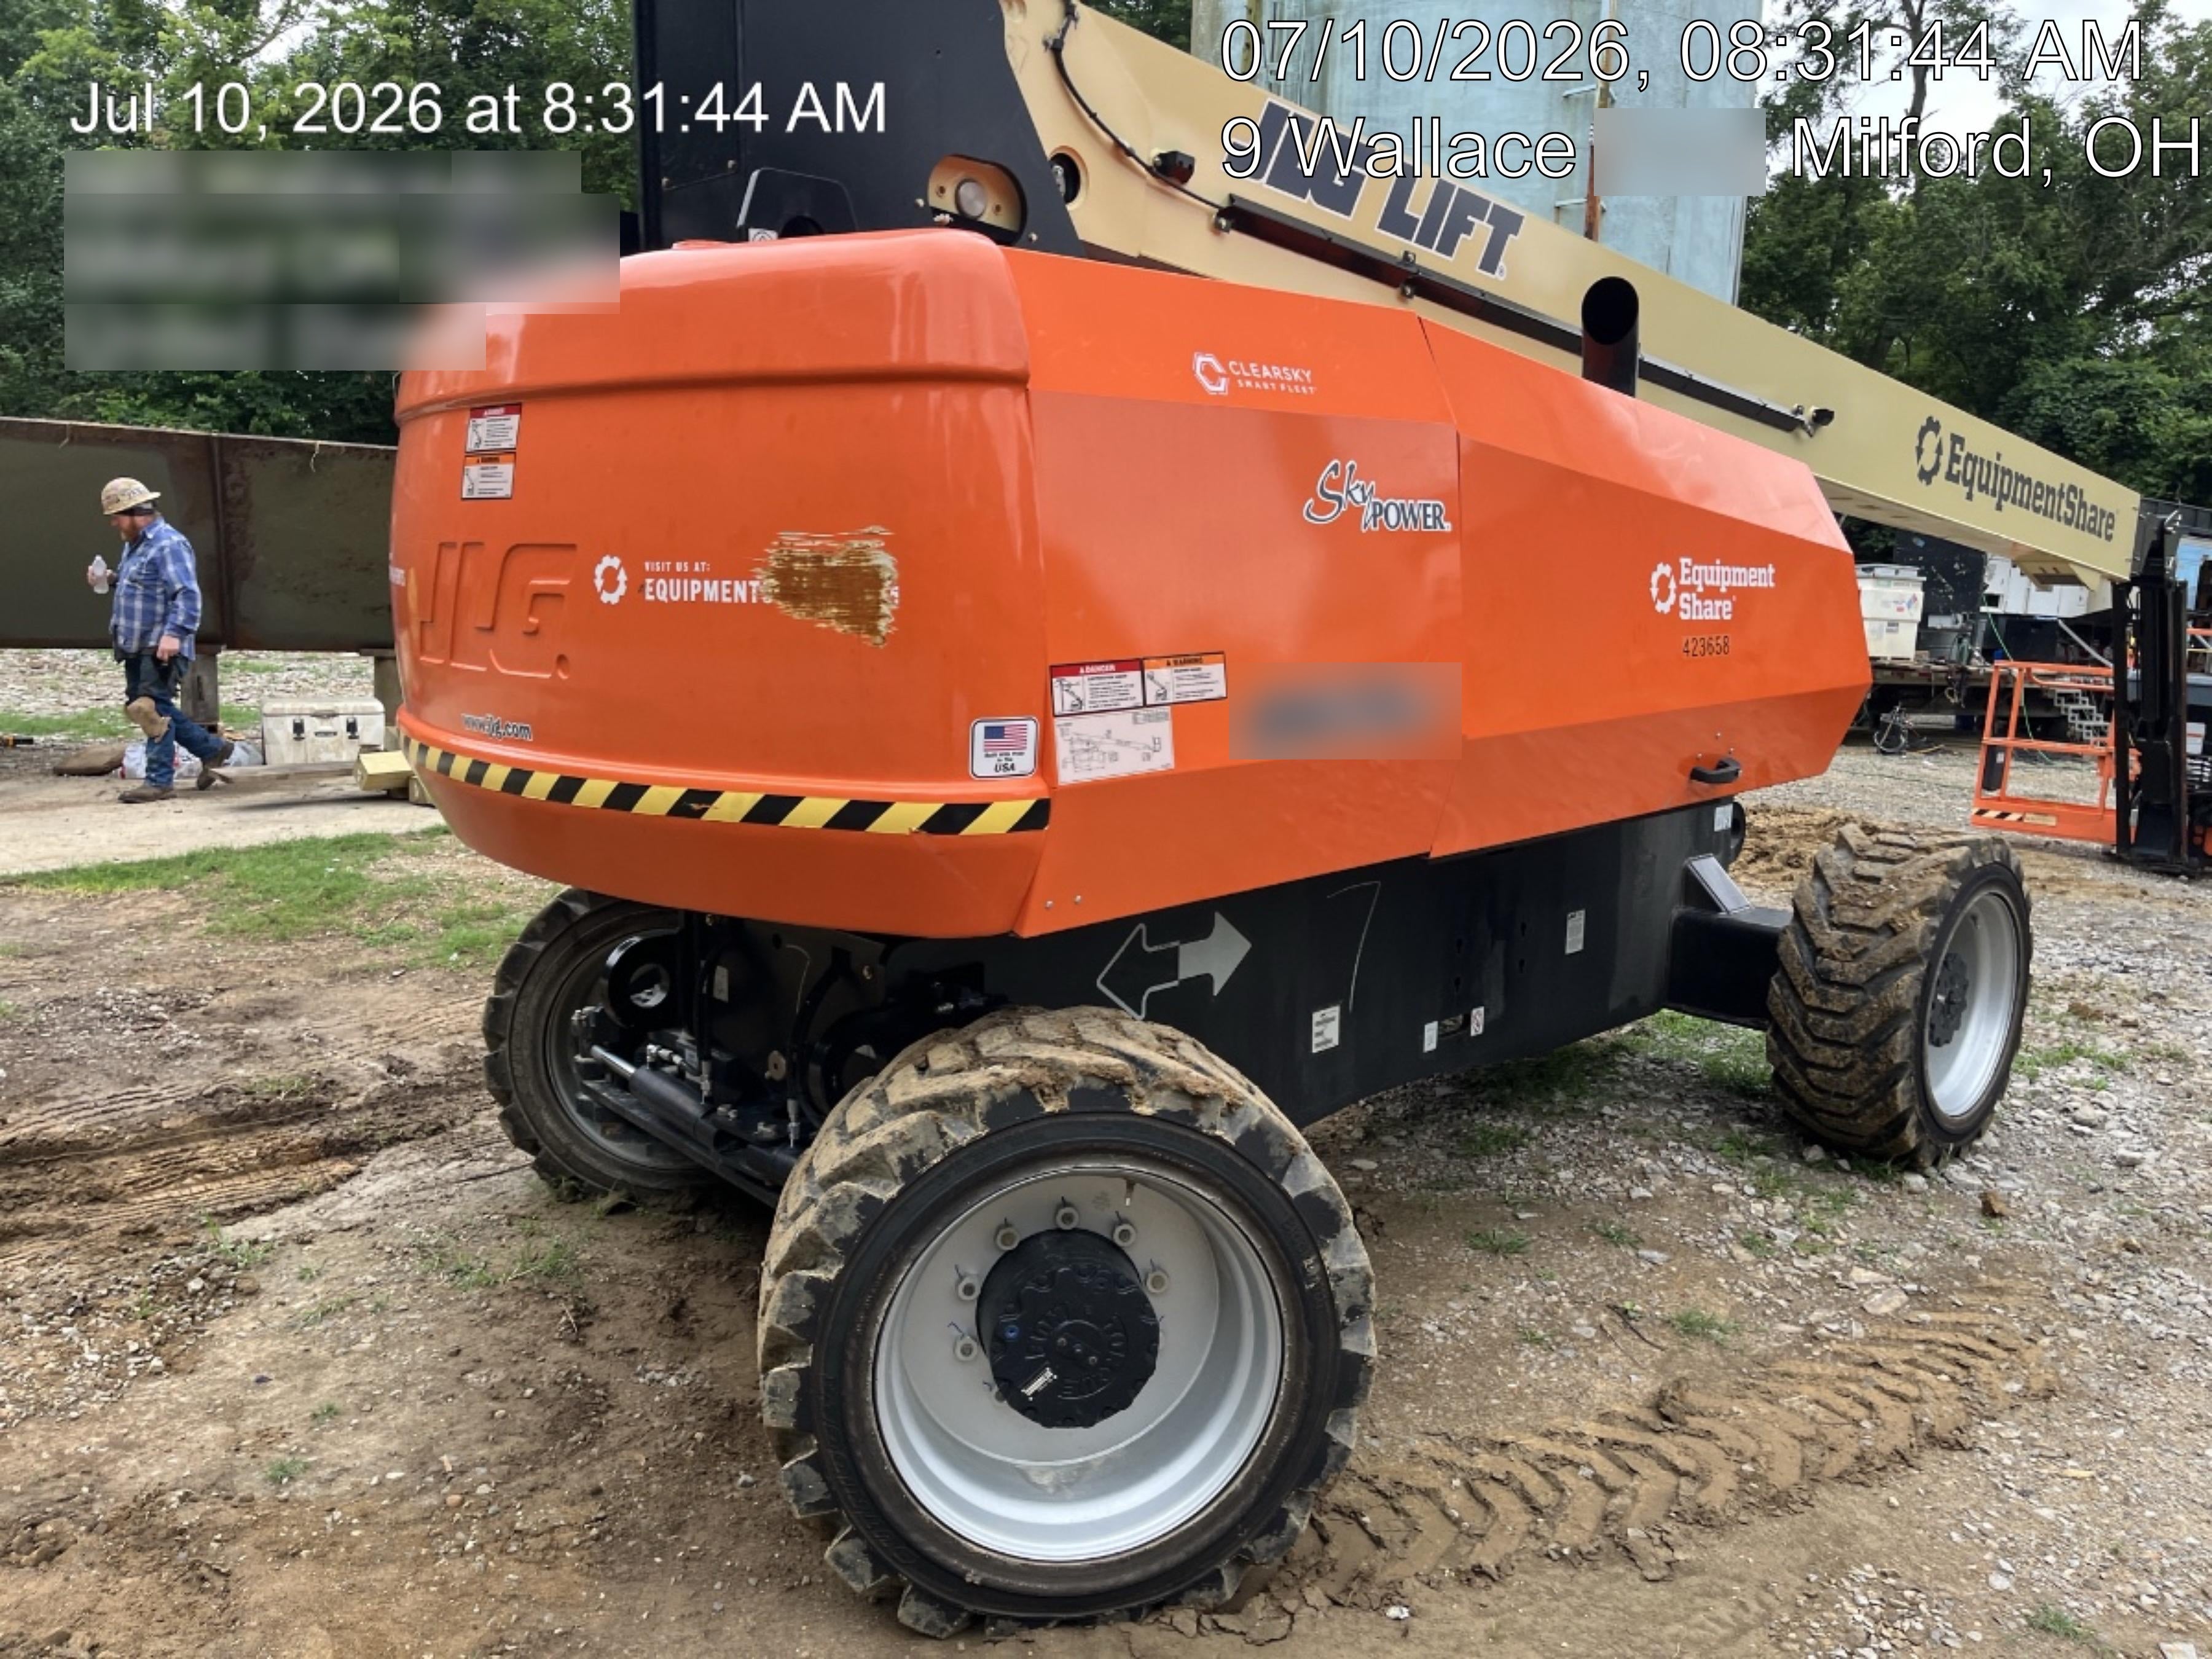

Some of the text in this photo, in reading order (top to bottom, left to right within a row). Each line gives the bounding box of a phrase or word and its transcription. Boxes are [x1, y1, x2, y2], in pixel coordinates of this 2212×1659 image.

[1375, 160, 1526, 278] LIFT
[1228, 360, 1312, 383] CLEARSKY
[1944, 433, 2115, 543] EquipmentShare
[645, 562, 672, 572] VISIT
[676, 562, 689, 572] US
[1679, 557, 1776, 592] Equipment
[1679, 592, 1733, 621] Share
[1682, 635, 1730, 657] 423658
